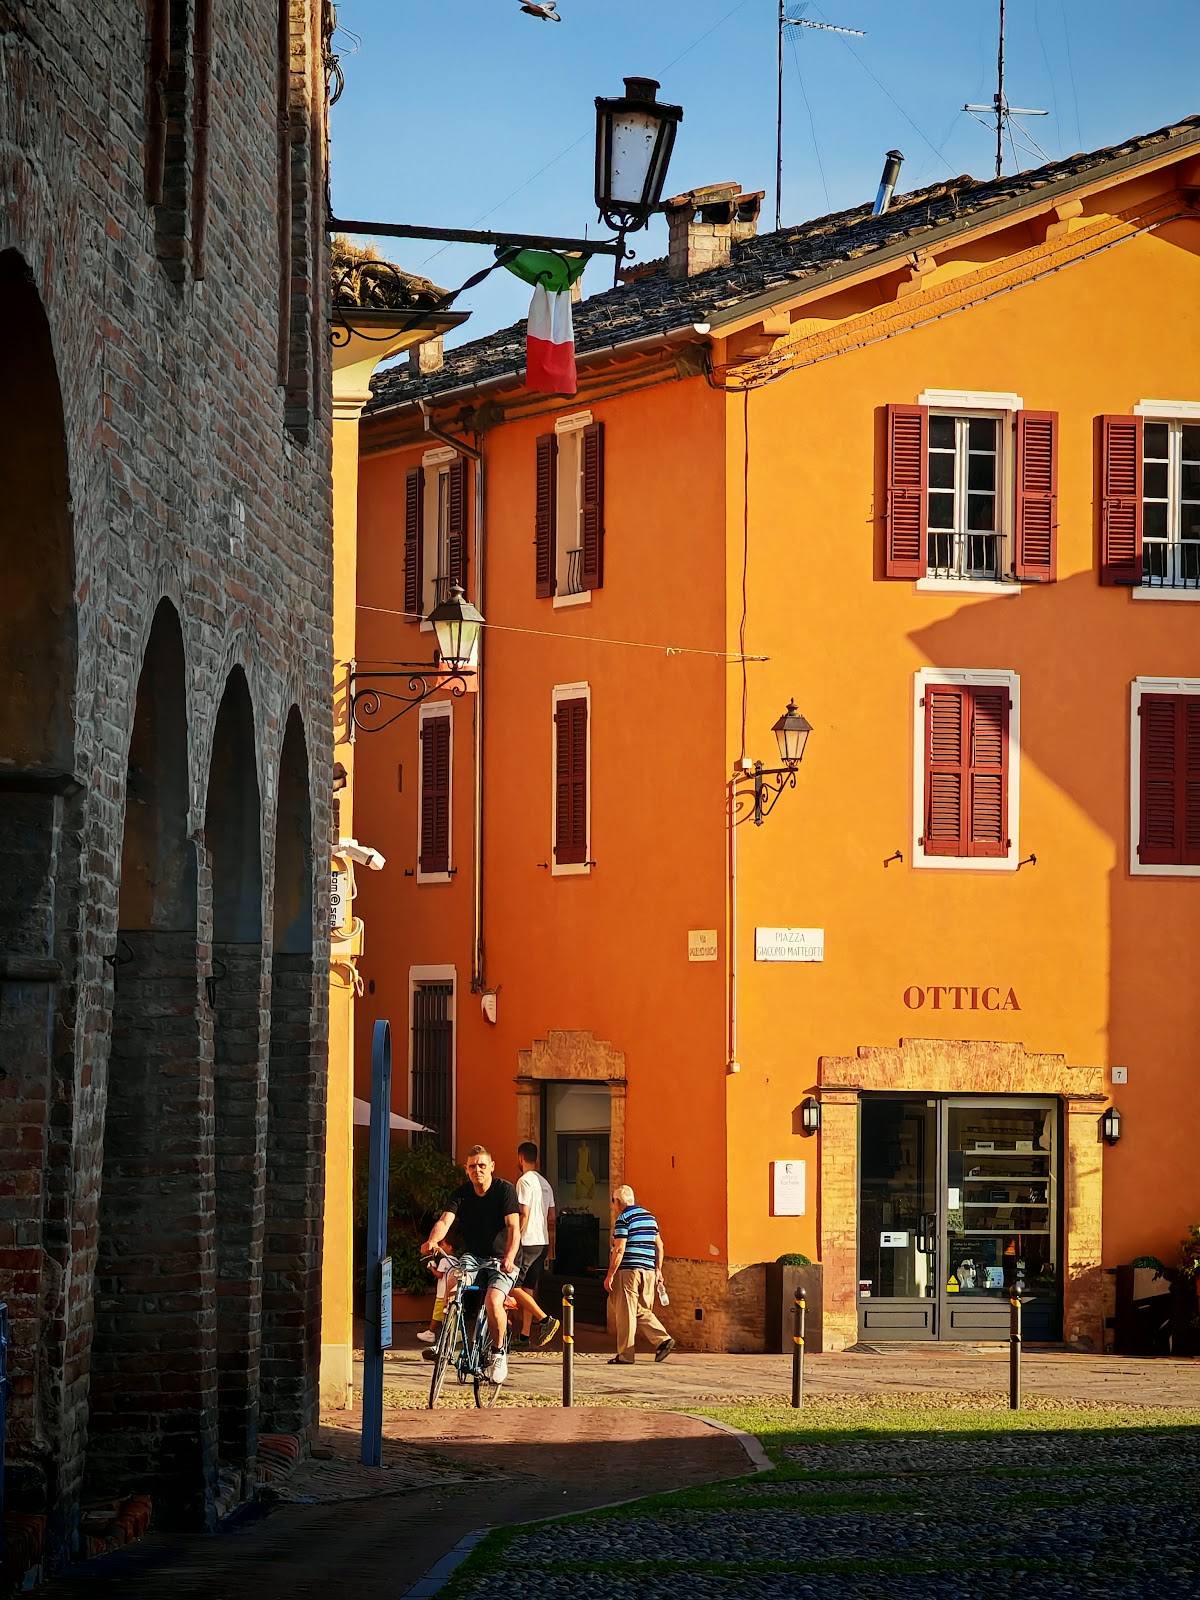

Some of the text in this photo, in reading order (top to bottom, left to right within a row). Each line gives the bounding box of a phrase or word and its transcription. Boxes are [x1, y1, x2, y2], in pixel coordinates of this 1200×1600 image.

[775, 932, 806, 943] PIAZZA
[757, 946, 823, 957] GIACOMO MATTEOTTI
[903, 985, 1022, 1011] OTTICA
